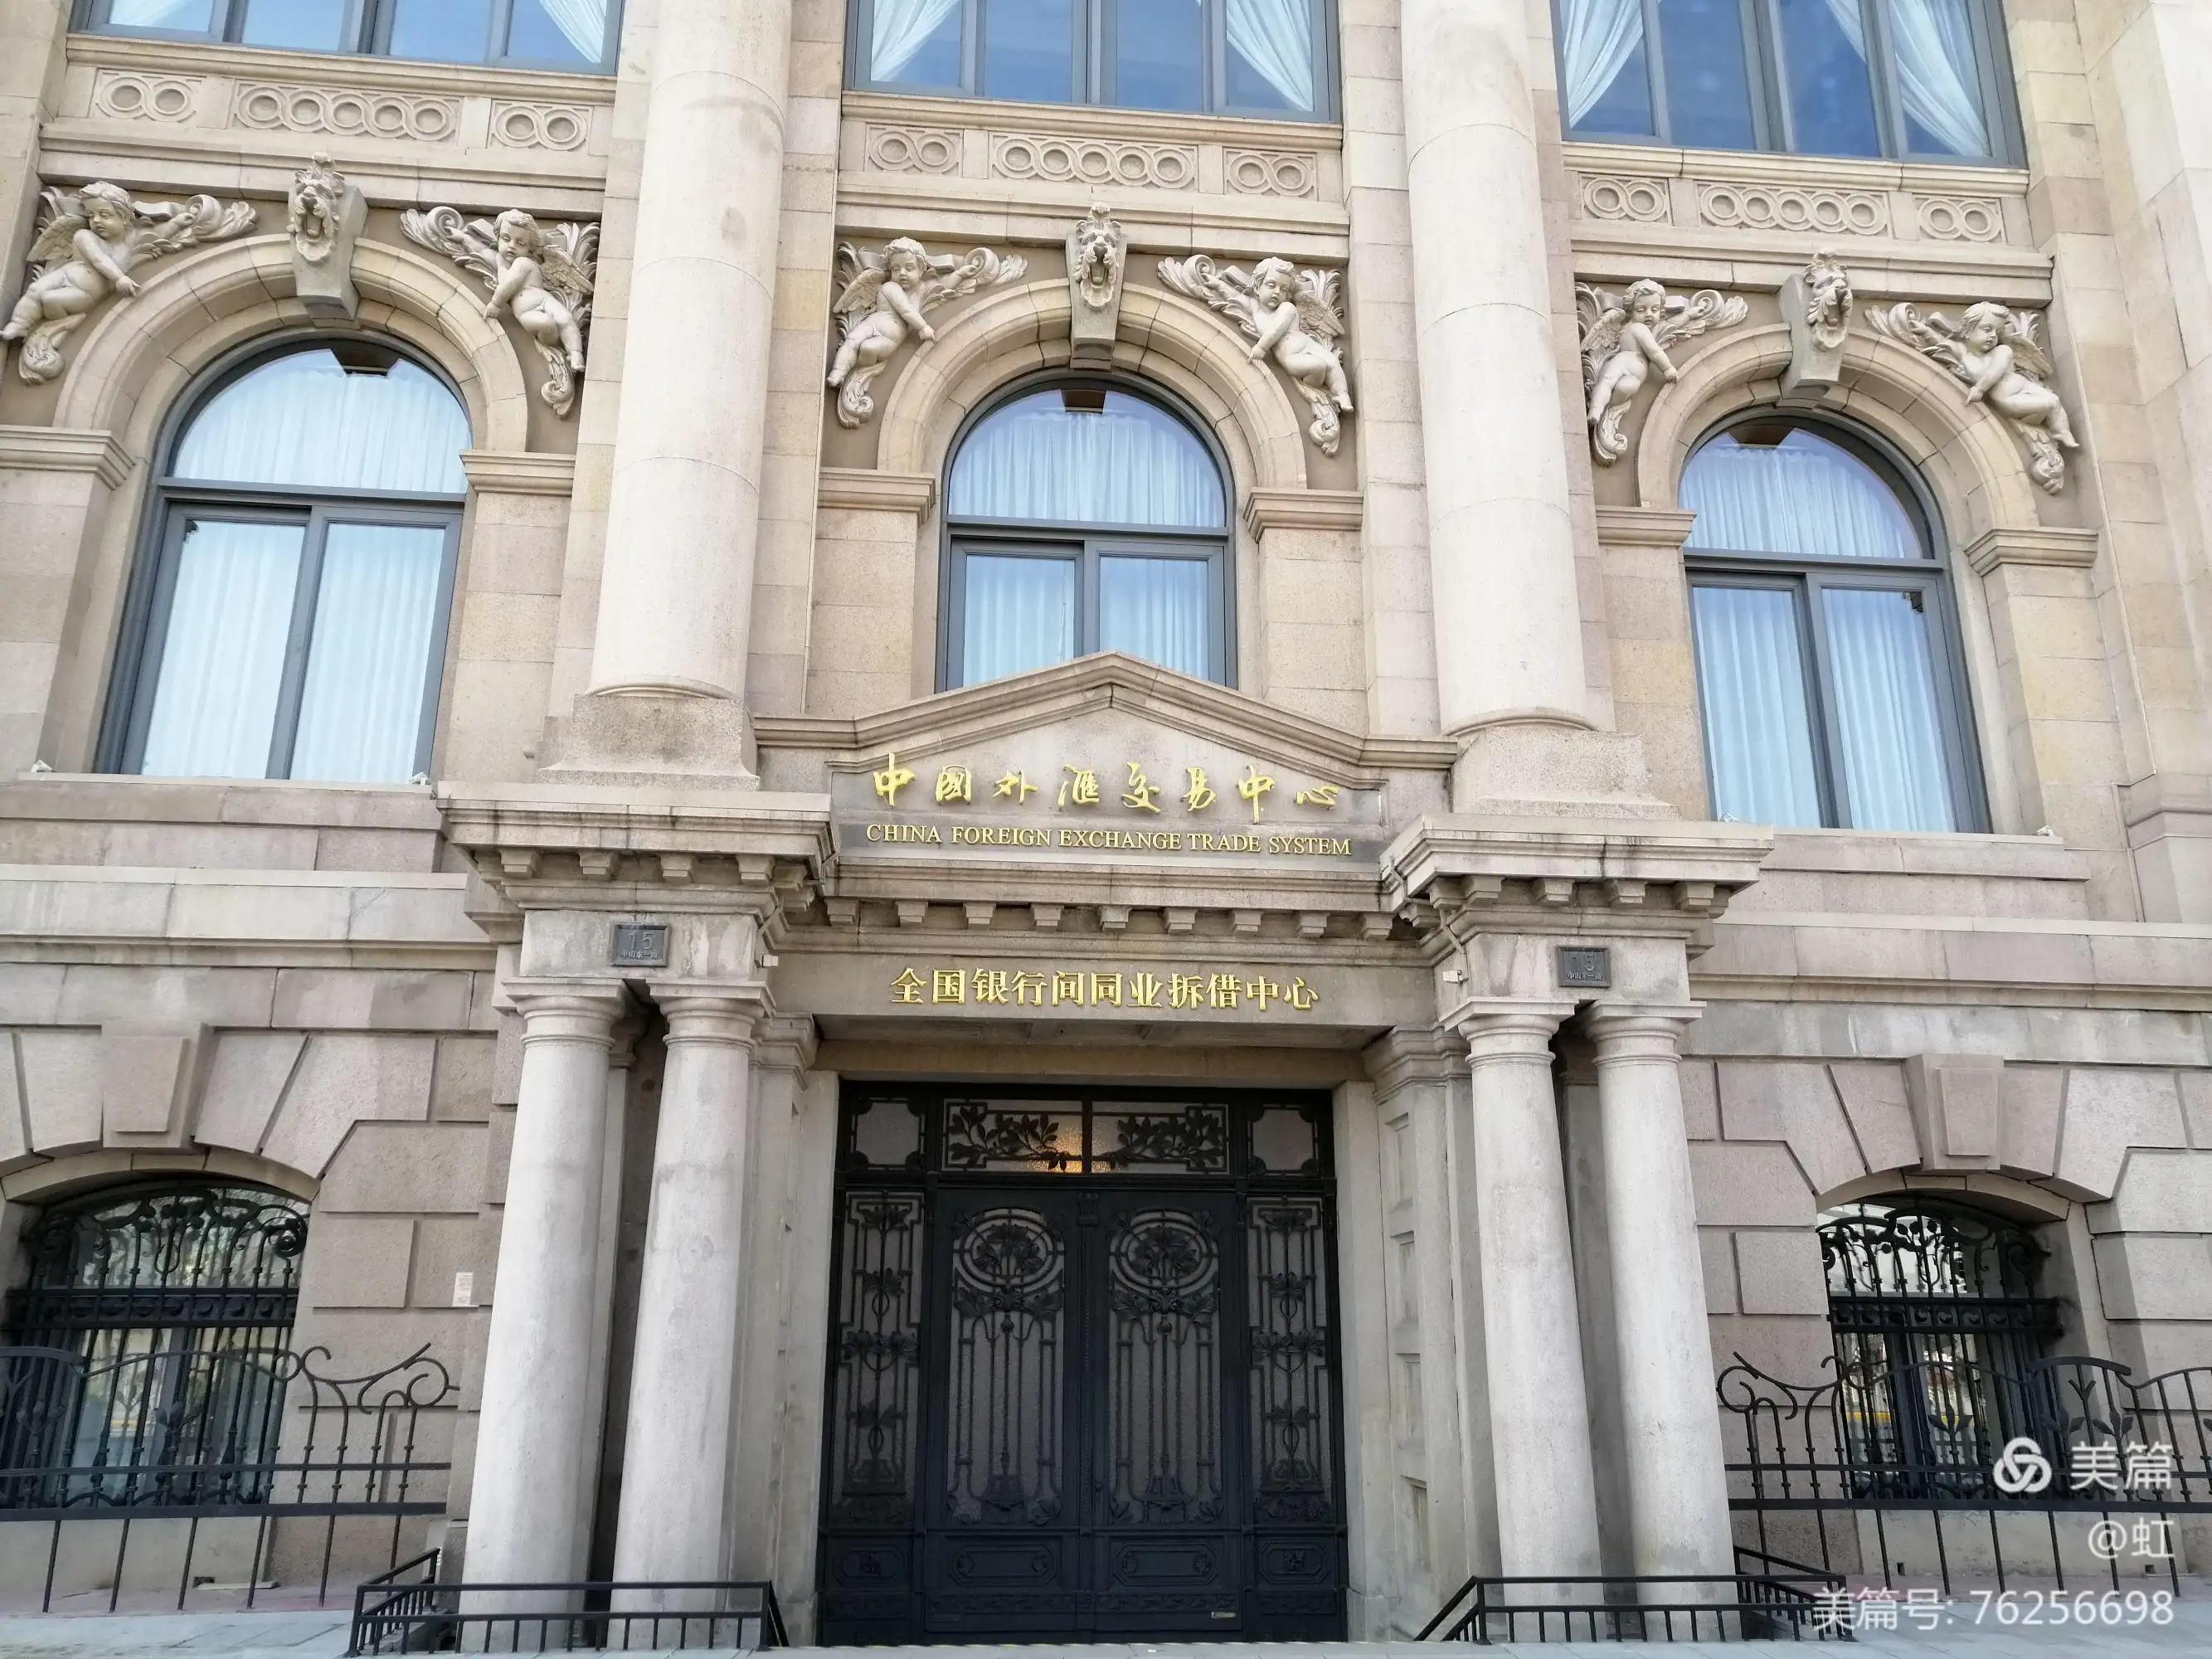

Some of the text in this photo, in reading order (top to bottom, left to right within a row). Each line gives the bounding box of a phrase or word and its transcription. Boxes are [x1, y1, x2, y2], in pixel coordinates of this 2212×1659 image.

[866, 824, 1352, 856] CHINA FOREIGN EXCHANGE TRADE SYSTEM
[890, 966, 1320, 1012] 全国银行间同业拆借中心
